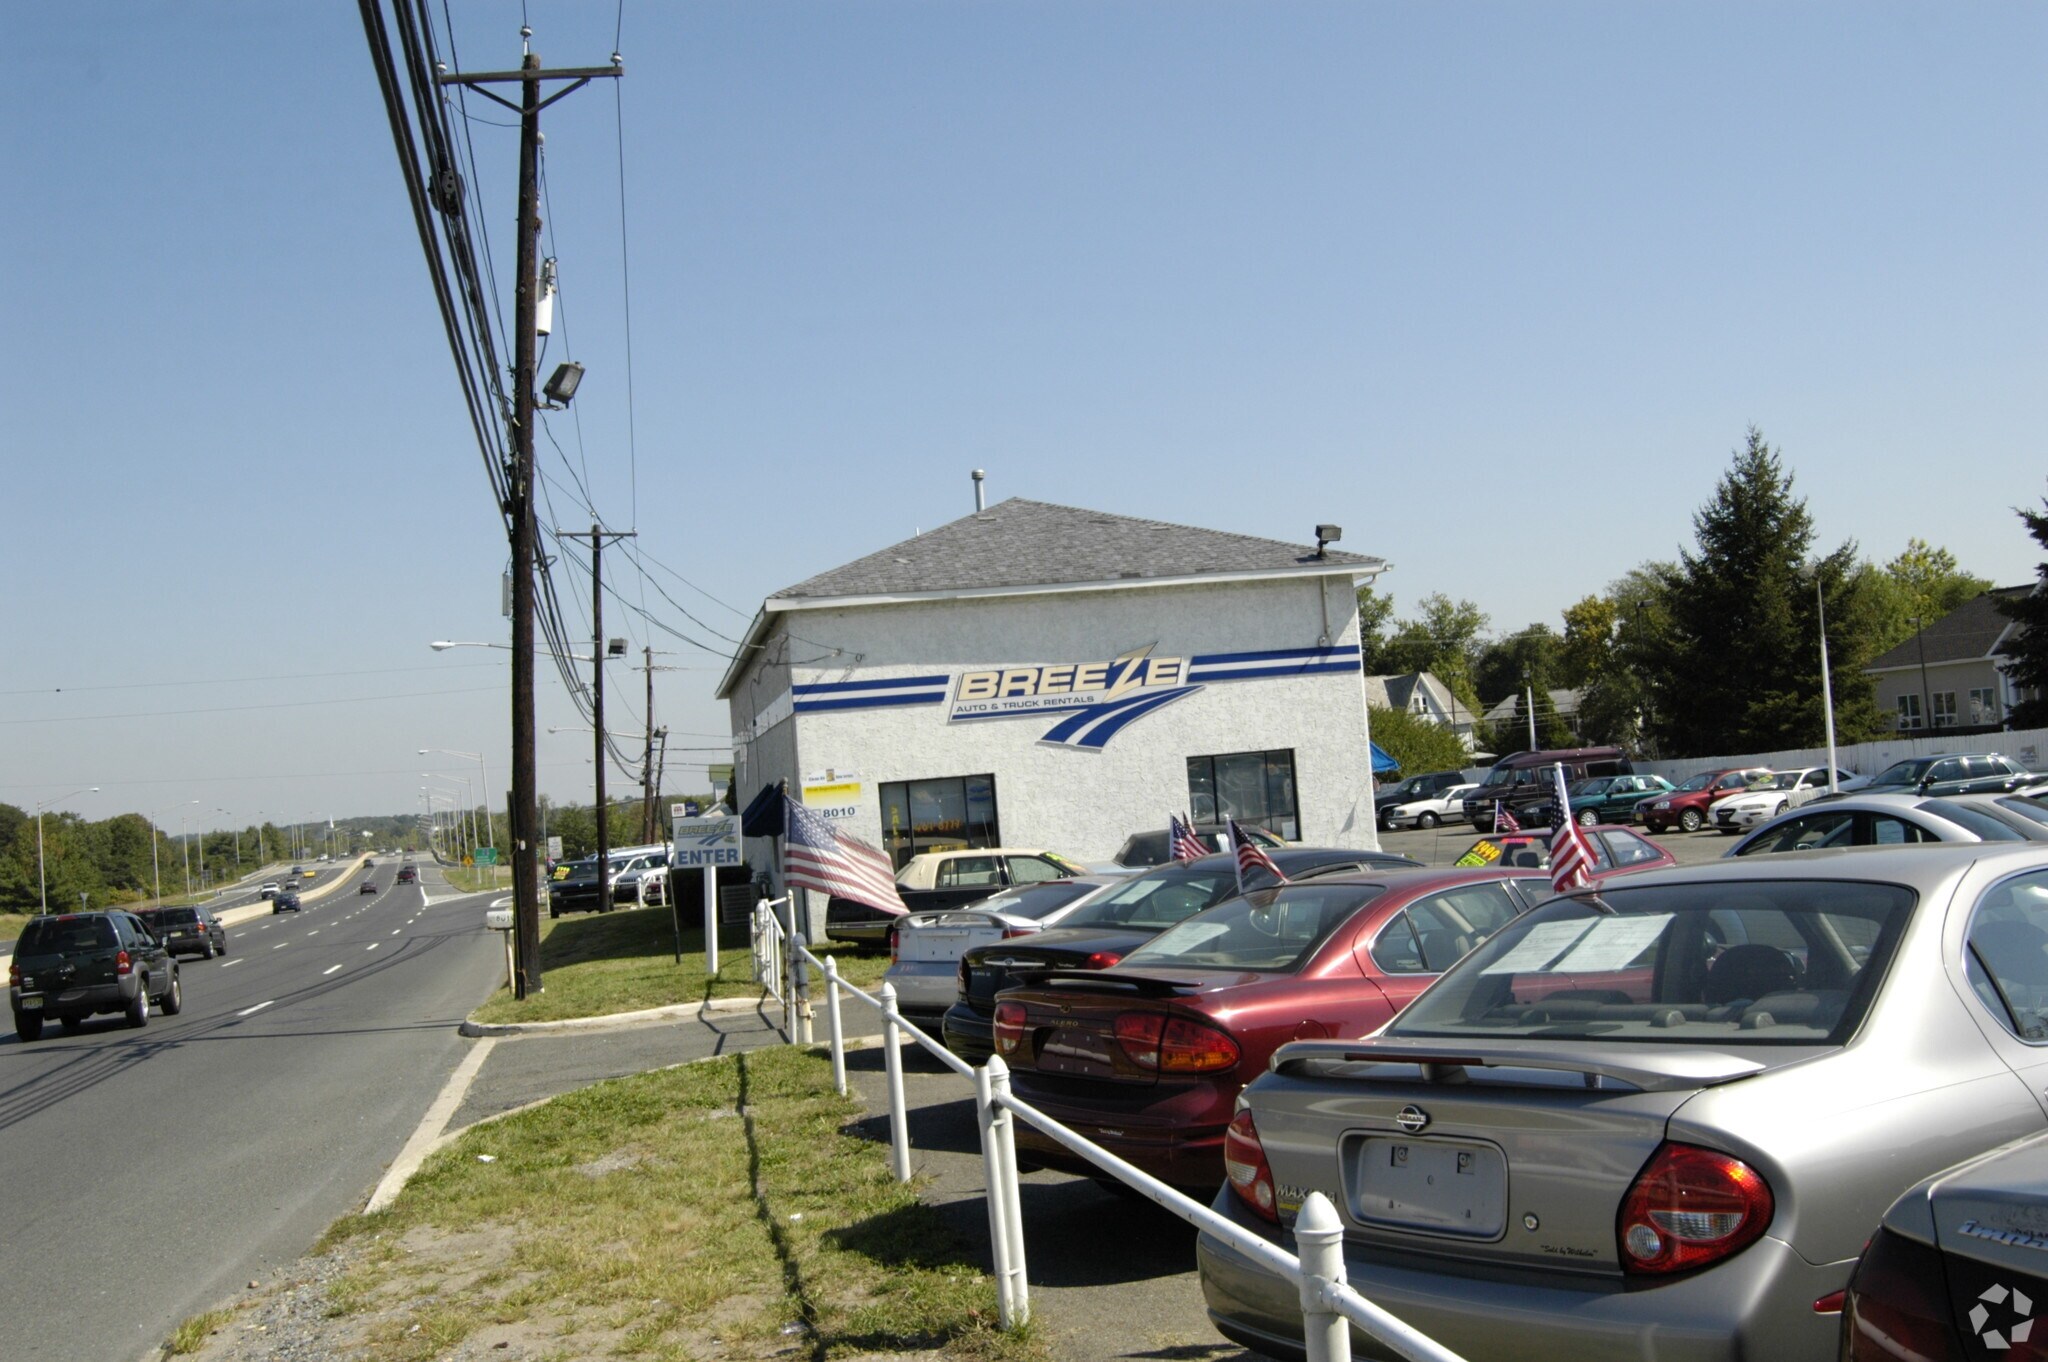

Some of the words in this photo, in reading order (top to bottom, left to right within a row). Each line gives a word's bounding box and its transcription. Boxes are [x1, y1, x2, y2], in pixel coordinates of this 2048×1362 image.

[956, 641, 1183, 702] BREEZE
[956, 704, 988, 713] AUTO
[991, 703, 999, 711] &
[1003, 700, 1040, 709] TRUCK
[1044, 695, 1095, 706] RENTALS
[823, 806, 856, 818] 8010
[678, 818, 734, 836] BREEZE
[677, 848, 739, 865] ENTER
[1276, 1184, 1337, 1204] MAXA
